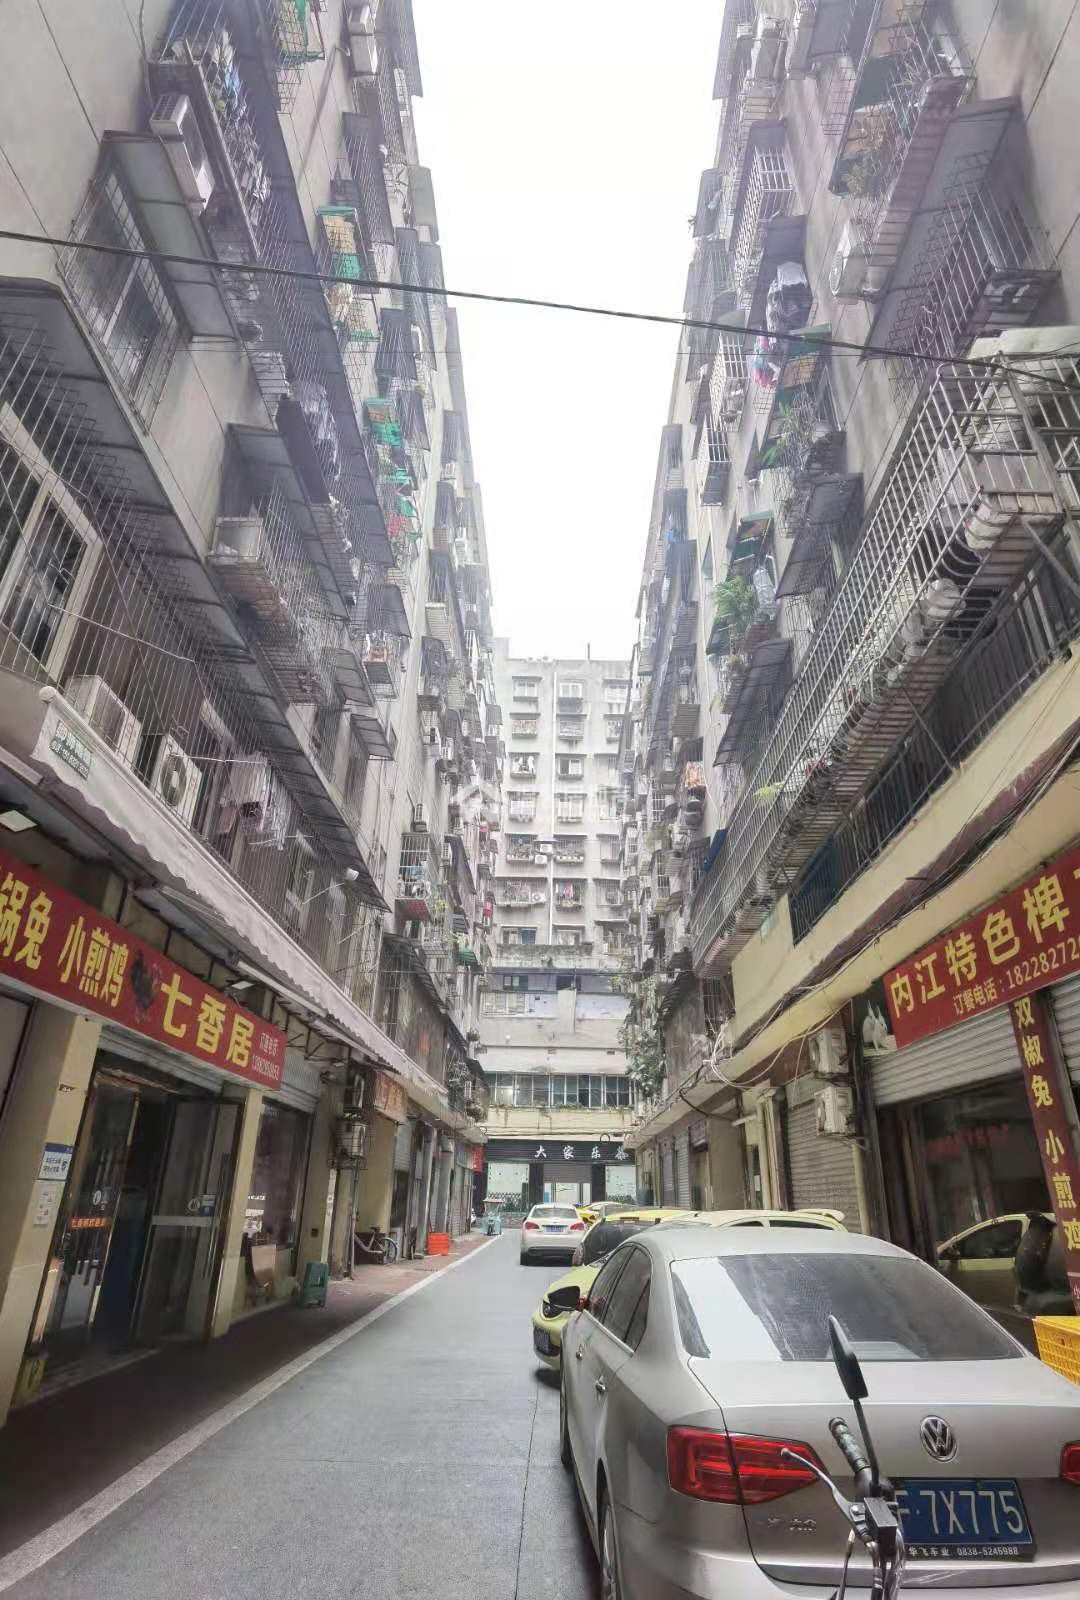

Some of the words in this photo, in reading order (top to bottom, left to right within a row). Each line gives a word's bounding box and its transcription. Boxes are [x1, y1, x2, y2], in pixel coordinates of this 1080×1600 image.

[57, 915, 129, 1007] 小煎鸡
[161, 973, 255, 1068] 七香居
[890, 868, 1080, 1018] 内江特色椑
[1006, 935, 1080, 990] 18228272
[1014, 997, 1053, 1108] 双椒兔
